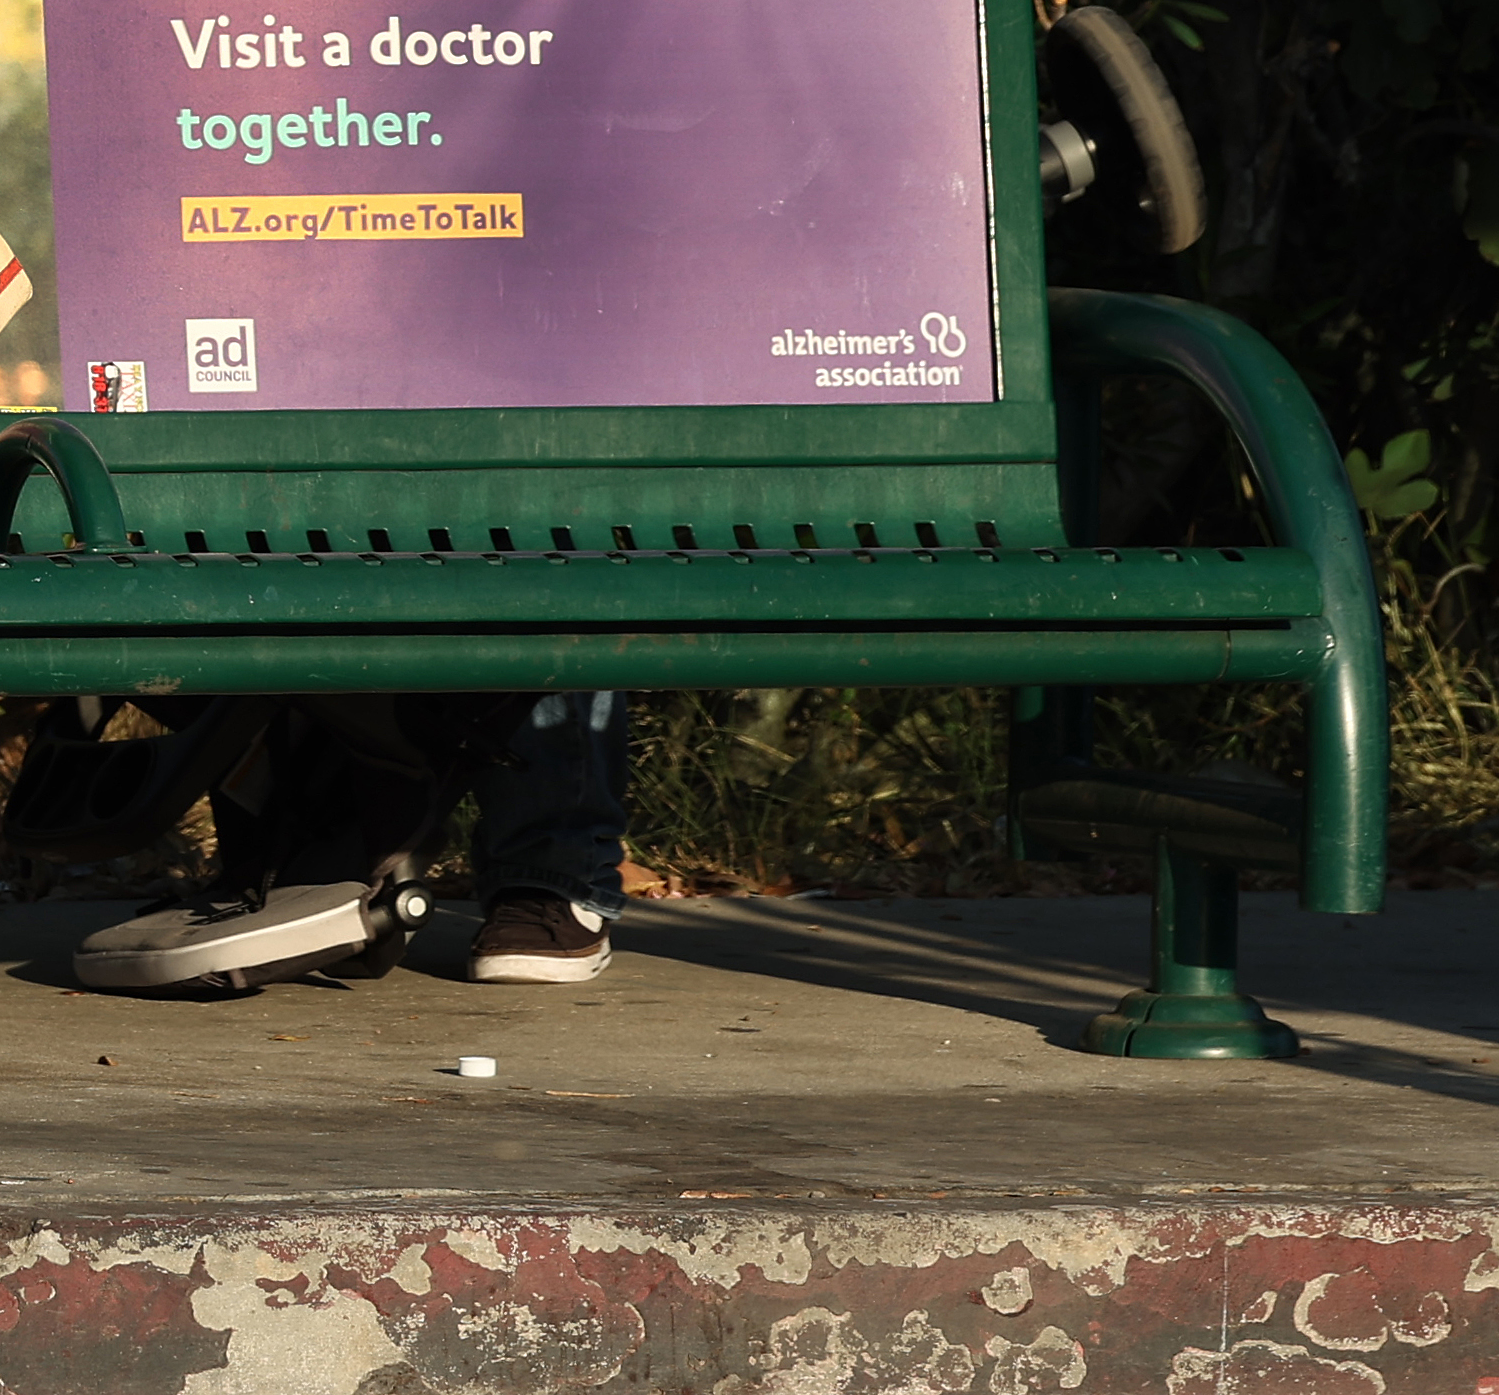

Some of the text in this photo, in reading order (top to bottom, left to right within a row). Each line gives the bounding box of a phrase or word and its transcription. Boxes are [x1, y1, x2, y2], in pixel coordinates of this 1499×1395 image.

[169, 14, 554, 70] Visit a doctor
[176, 97, 444, 165] together.
[187, 204, 519, 240] ALZ.org/TimeToTalk
[194, 325, 249, 368] ad
[770, 328, 916, 356] alzheimer's
[195, 370, 253, 383] COUNCIL
[814, 361, 962, 387] association
